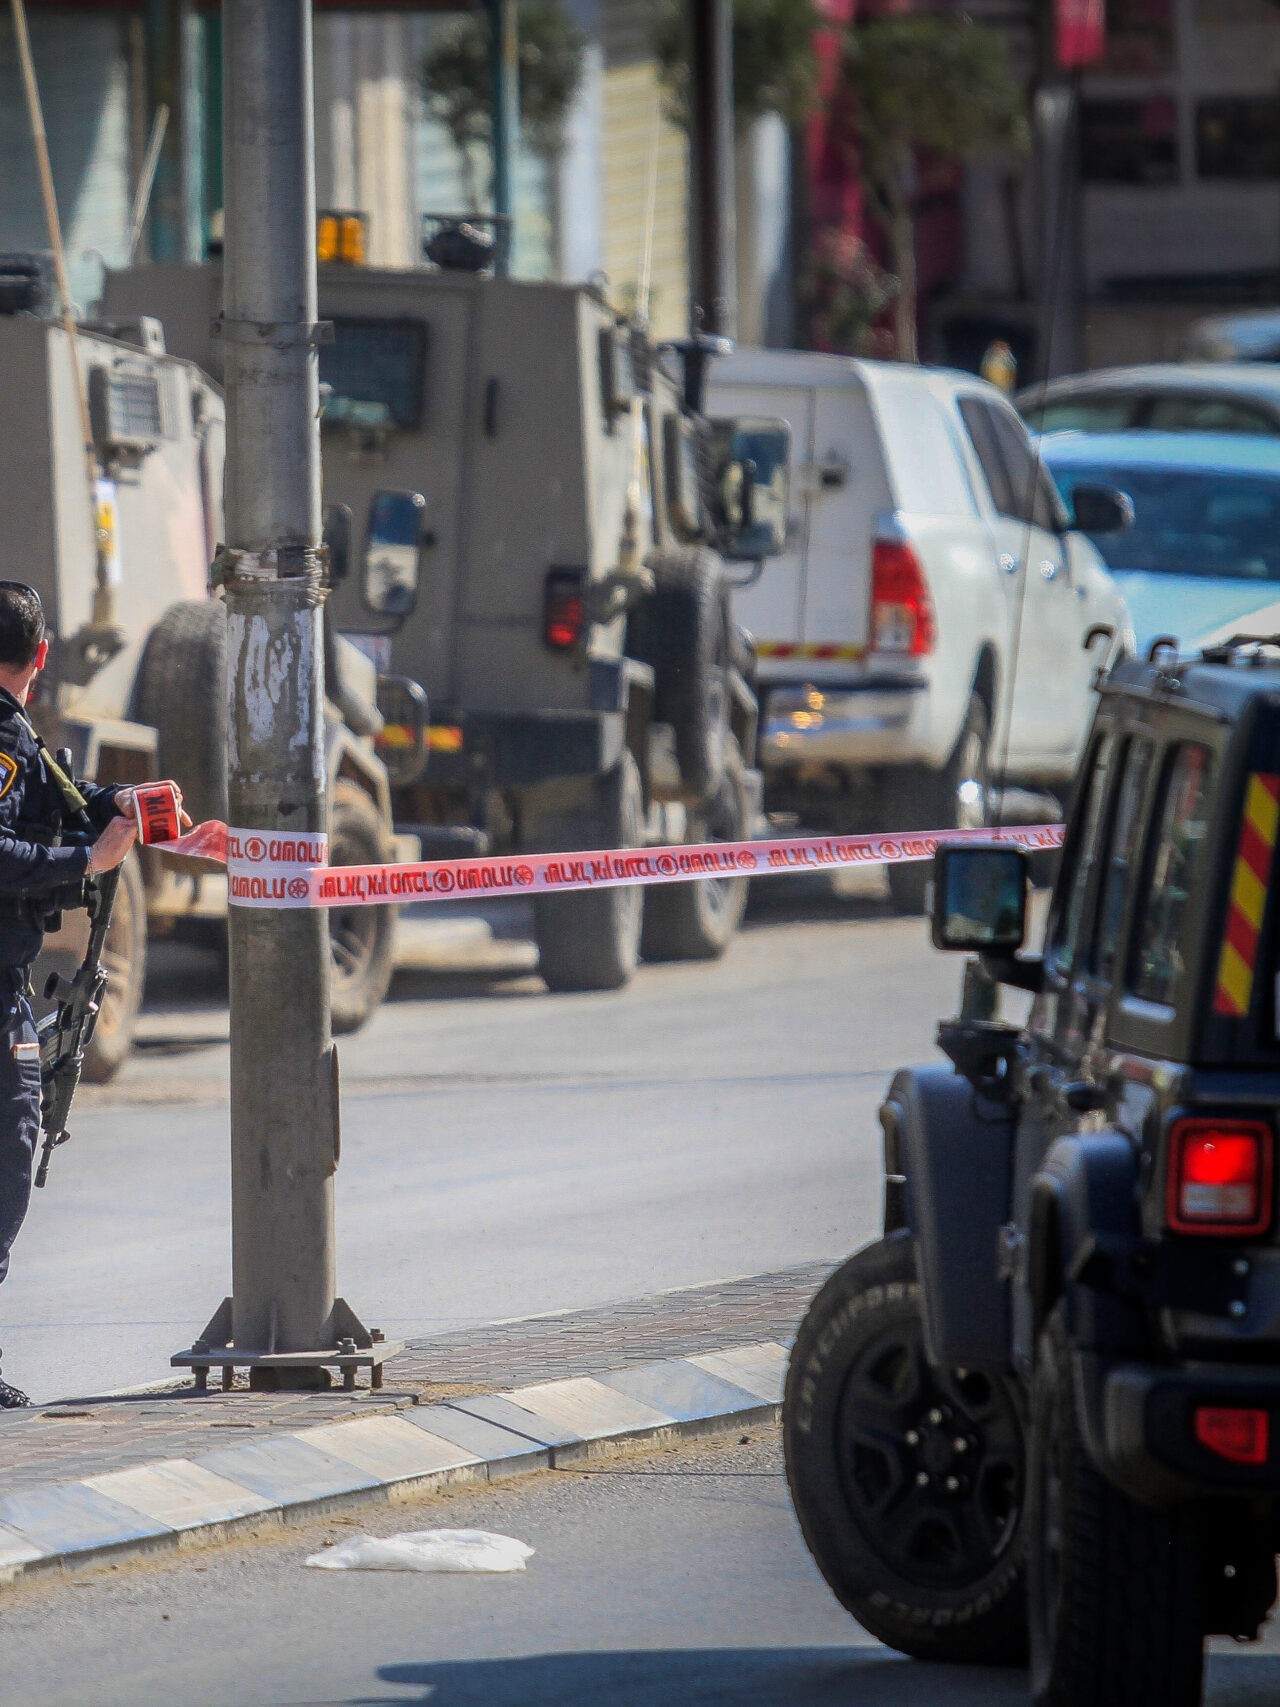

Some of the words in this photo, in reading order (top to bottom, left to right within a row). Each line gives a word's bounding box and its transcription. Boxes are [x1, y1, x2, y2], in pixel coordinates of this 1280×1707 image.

[231, 875, 288, 899] משטרת
[319, 874, 366, 902] ישראל
[367, 869, 388, 896] אין
[390, 871, 433, 895] מעבר
[456, 865, 513, 890] משטרת
[544, 860, 592, 885] ישראל
[590, 854, 614, 880] אין
[614, 857, 658, 879] מעבר
[679, 851, 737, 874] משטרת
[767, 848, 818, 867] ישראל
[814, 840, 837, 863] אין
[836, 843, 881, 862] מעבר
[901, 838, 937, 857] משט
